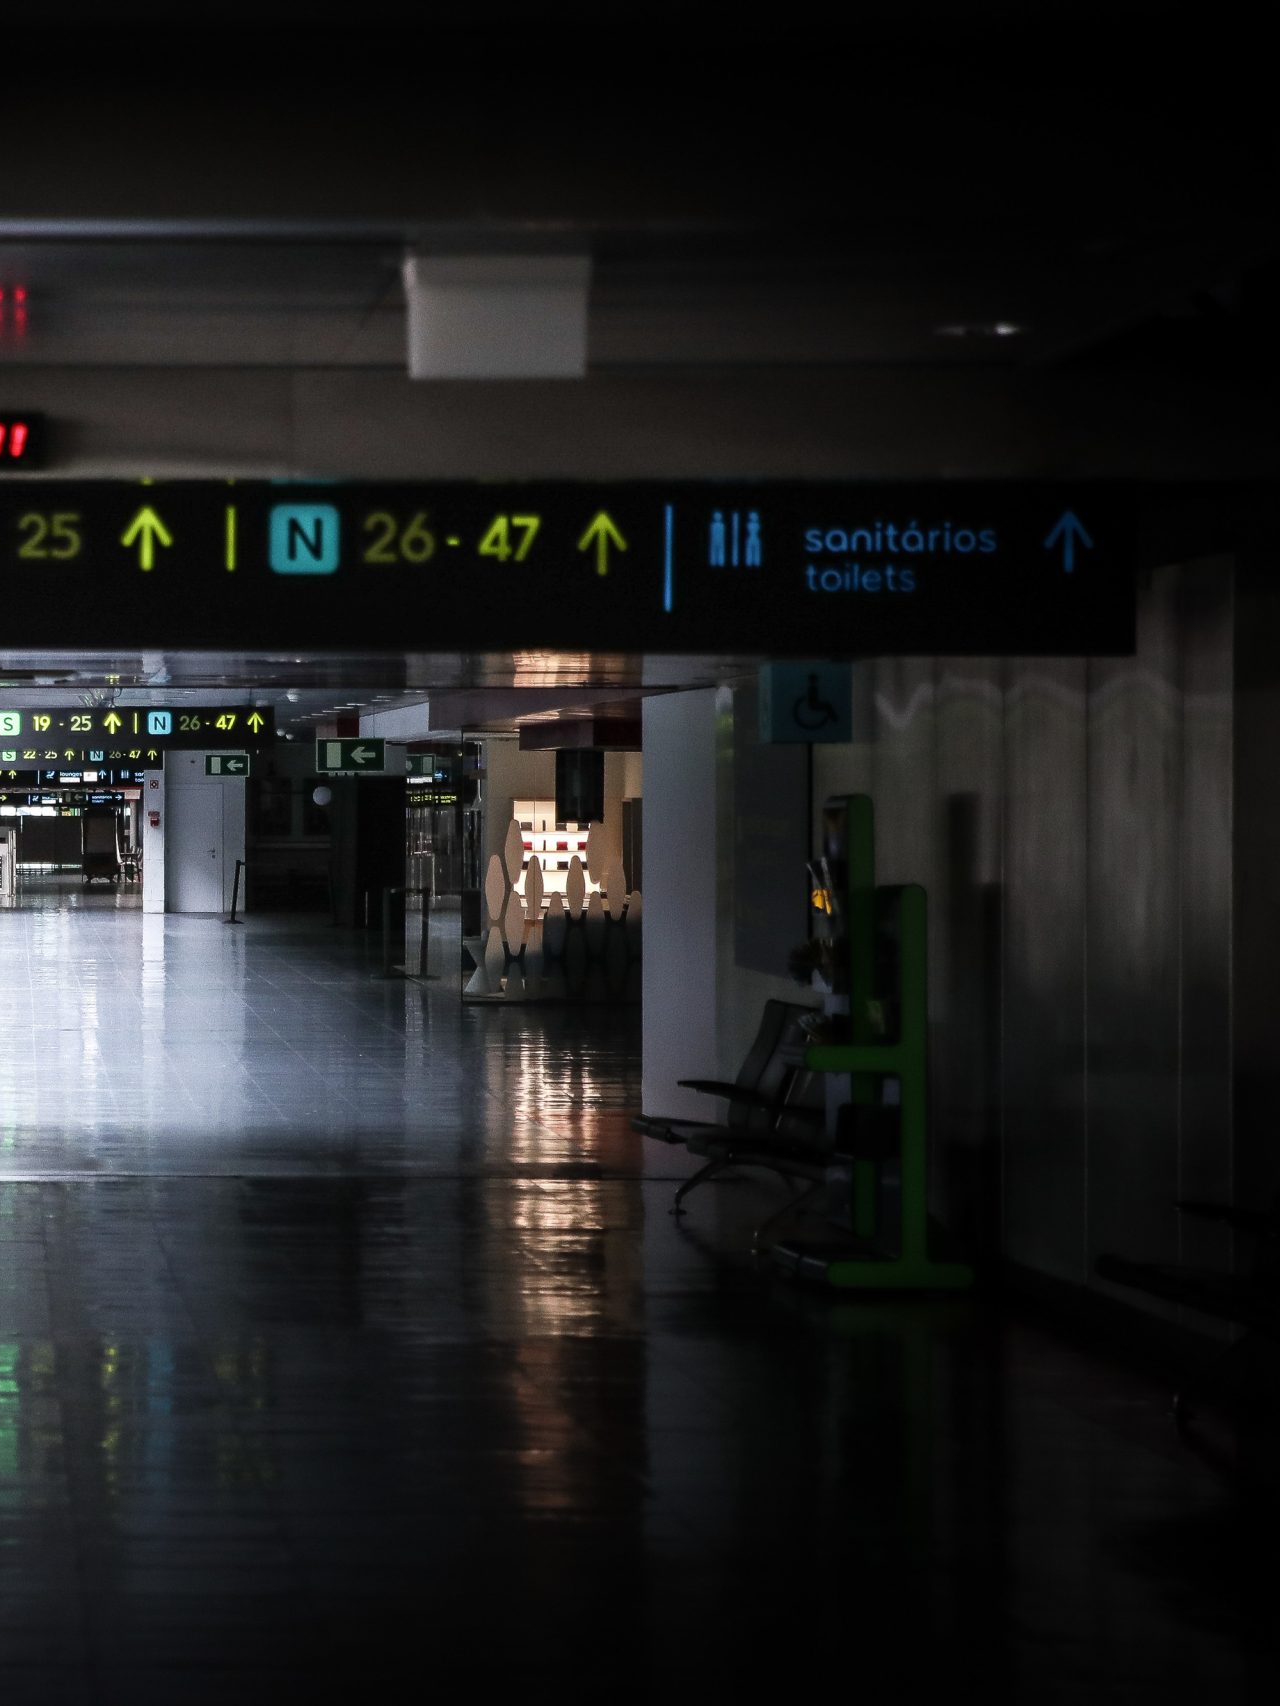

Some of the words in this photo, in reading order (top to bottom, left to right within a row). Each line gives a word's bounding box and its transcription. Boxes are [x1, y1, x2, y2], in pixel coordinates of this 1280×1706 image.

[17, 512, 82, 560] 25
[287, 517, 324, 562] N
[362, 511, 436, 563] 26
[478, 514, 541, 561] 47
[803, 519, 997, 554] sanitários
[804, 562, 917, 593] toilets
[32, 715, 51, 732] 19
[70, 715, 93, 732] 25
[179, 715, 201, 731] 26
[215, 714, 237, 731] 47
[129, 750, 141, 759] 47
